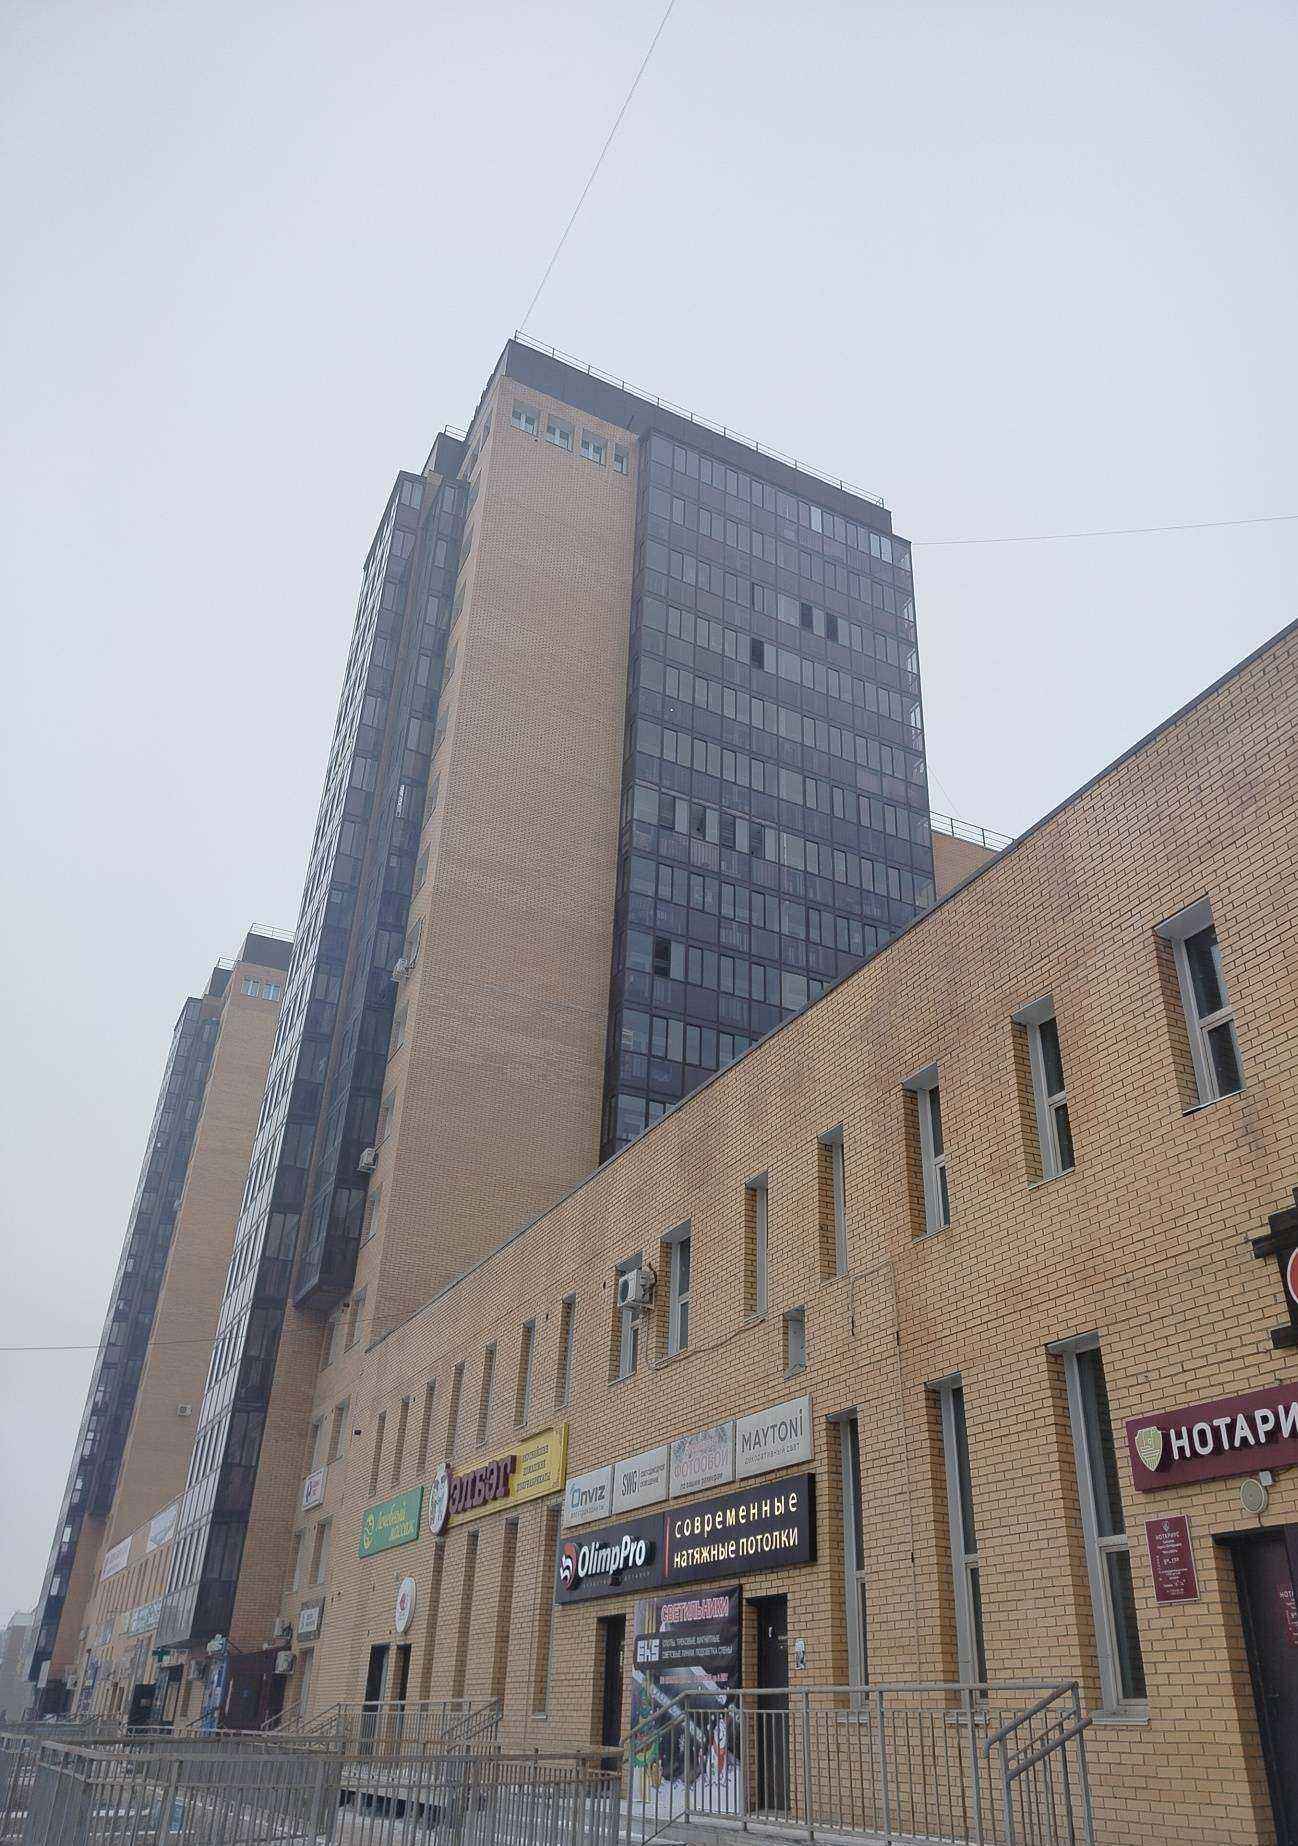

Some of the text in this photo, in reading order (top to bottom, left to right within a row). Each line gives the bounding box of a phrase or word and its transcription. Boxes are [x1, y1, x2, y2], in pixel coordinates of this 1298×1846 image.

[674, 1492, 798, 1538] современные
[577, 1535, 646, 1577] OlimpPro
[673, 1527, 799, 1568] натяжные потолки
